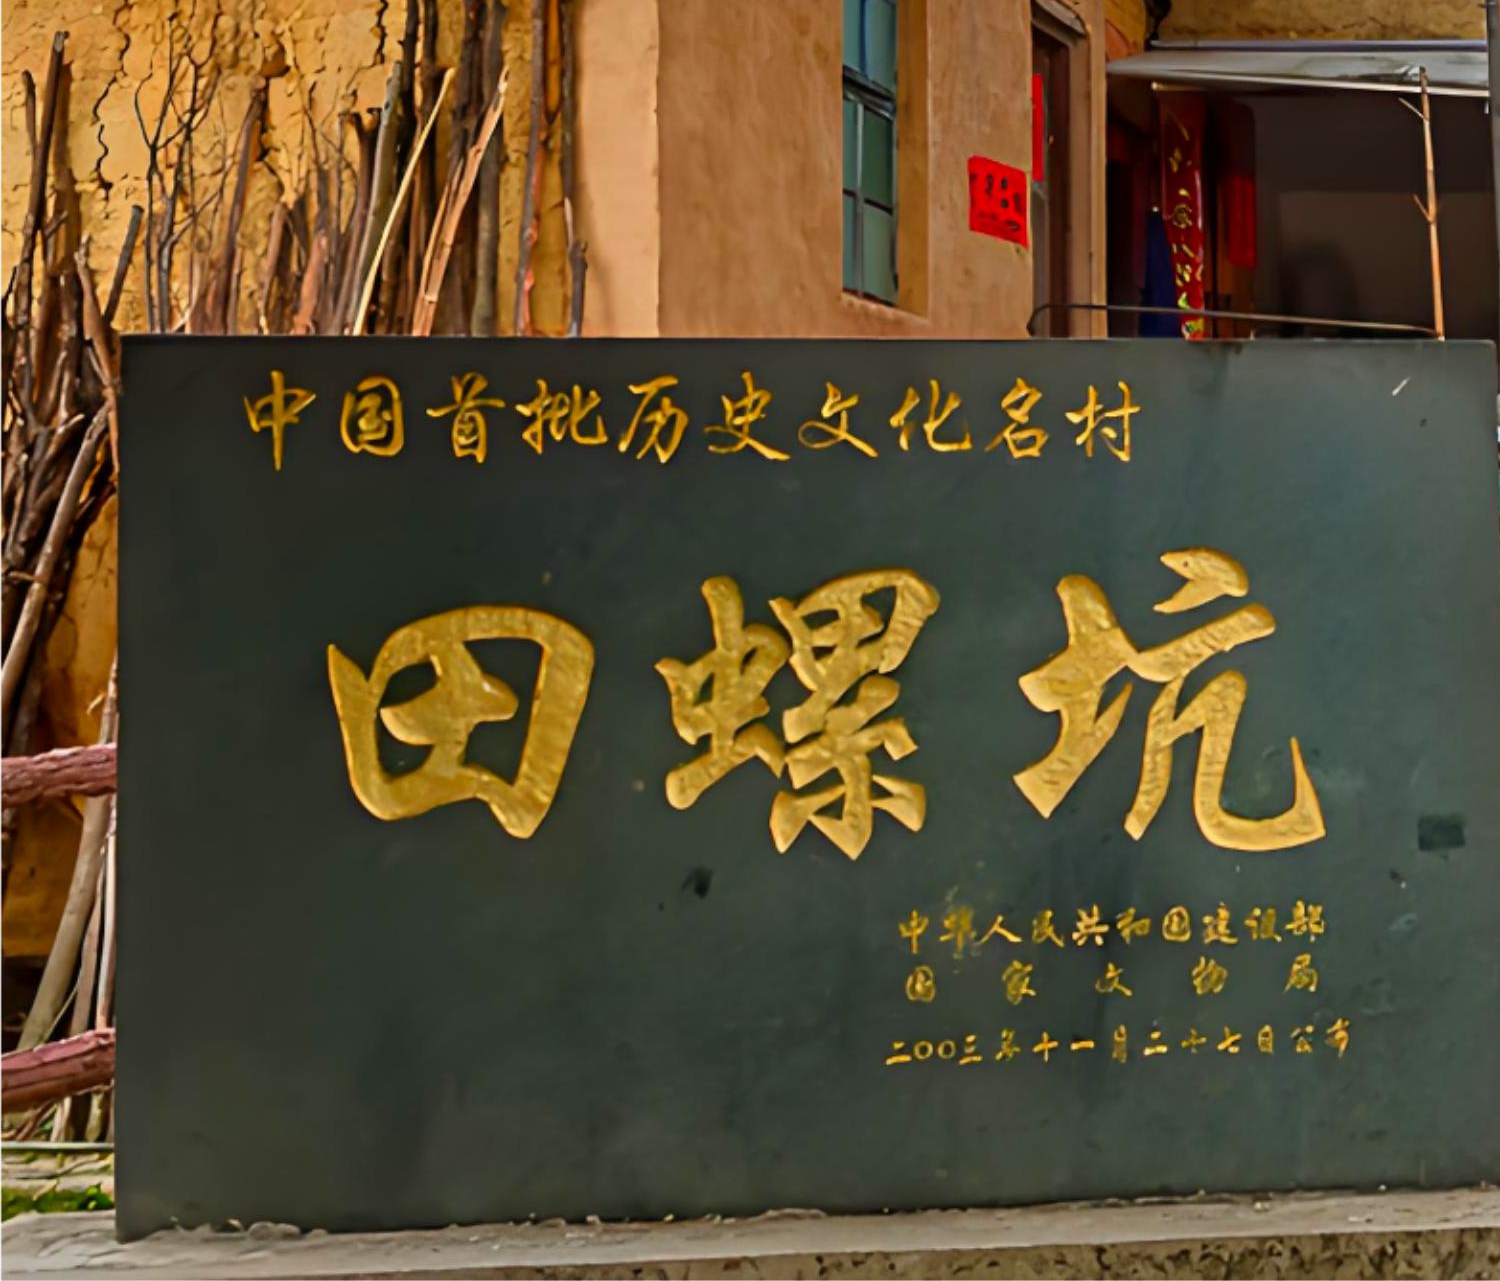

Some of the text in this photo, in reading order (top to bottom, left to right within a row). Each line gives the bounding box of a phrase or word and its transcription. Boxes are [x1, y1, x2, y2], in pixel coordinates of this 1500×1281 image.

[243, 370, 1141, 471] 中国首批历史文化名村
[327, 547, 1327, 860] 田螺坑
[899, 900, 1325, 955] 中华人民共和国建设部
[905, 954, 1319, 1005] 国家文物局
